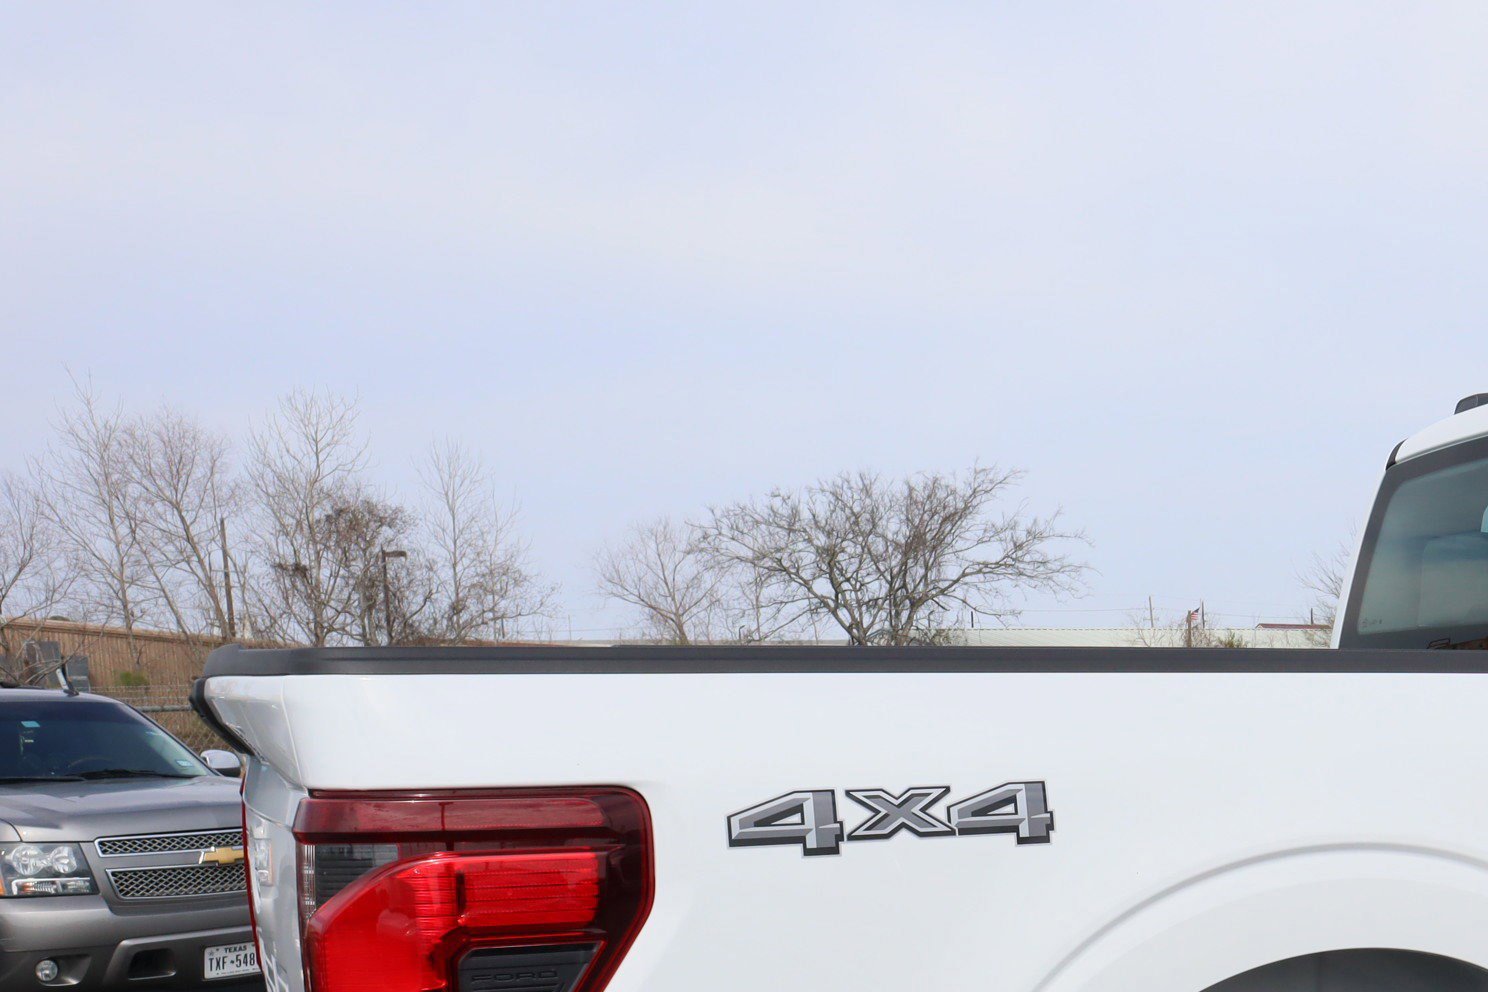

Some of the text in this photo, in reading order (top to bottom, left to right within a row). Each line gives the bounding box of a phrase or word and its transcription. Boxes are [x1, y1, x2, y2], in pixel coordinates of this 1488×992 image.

[727, 780, 1055, 857] 4X4
[224, 944, 248, 953] TEXAS
[471, 970, 559, 984] FORD
